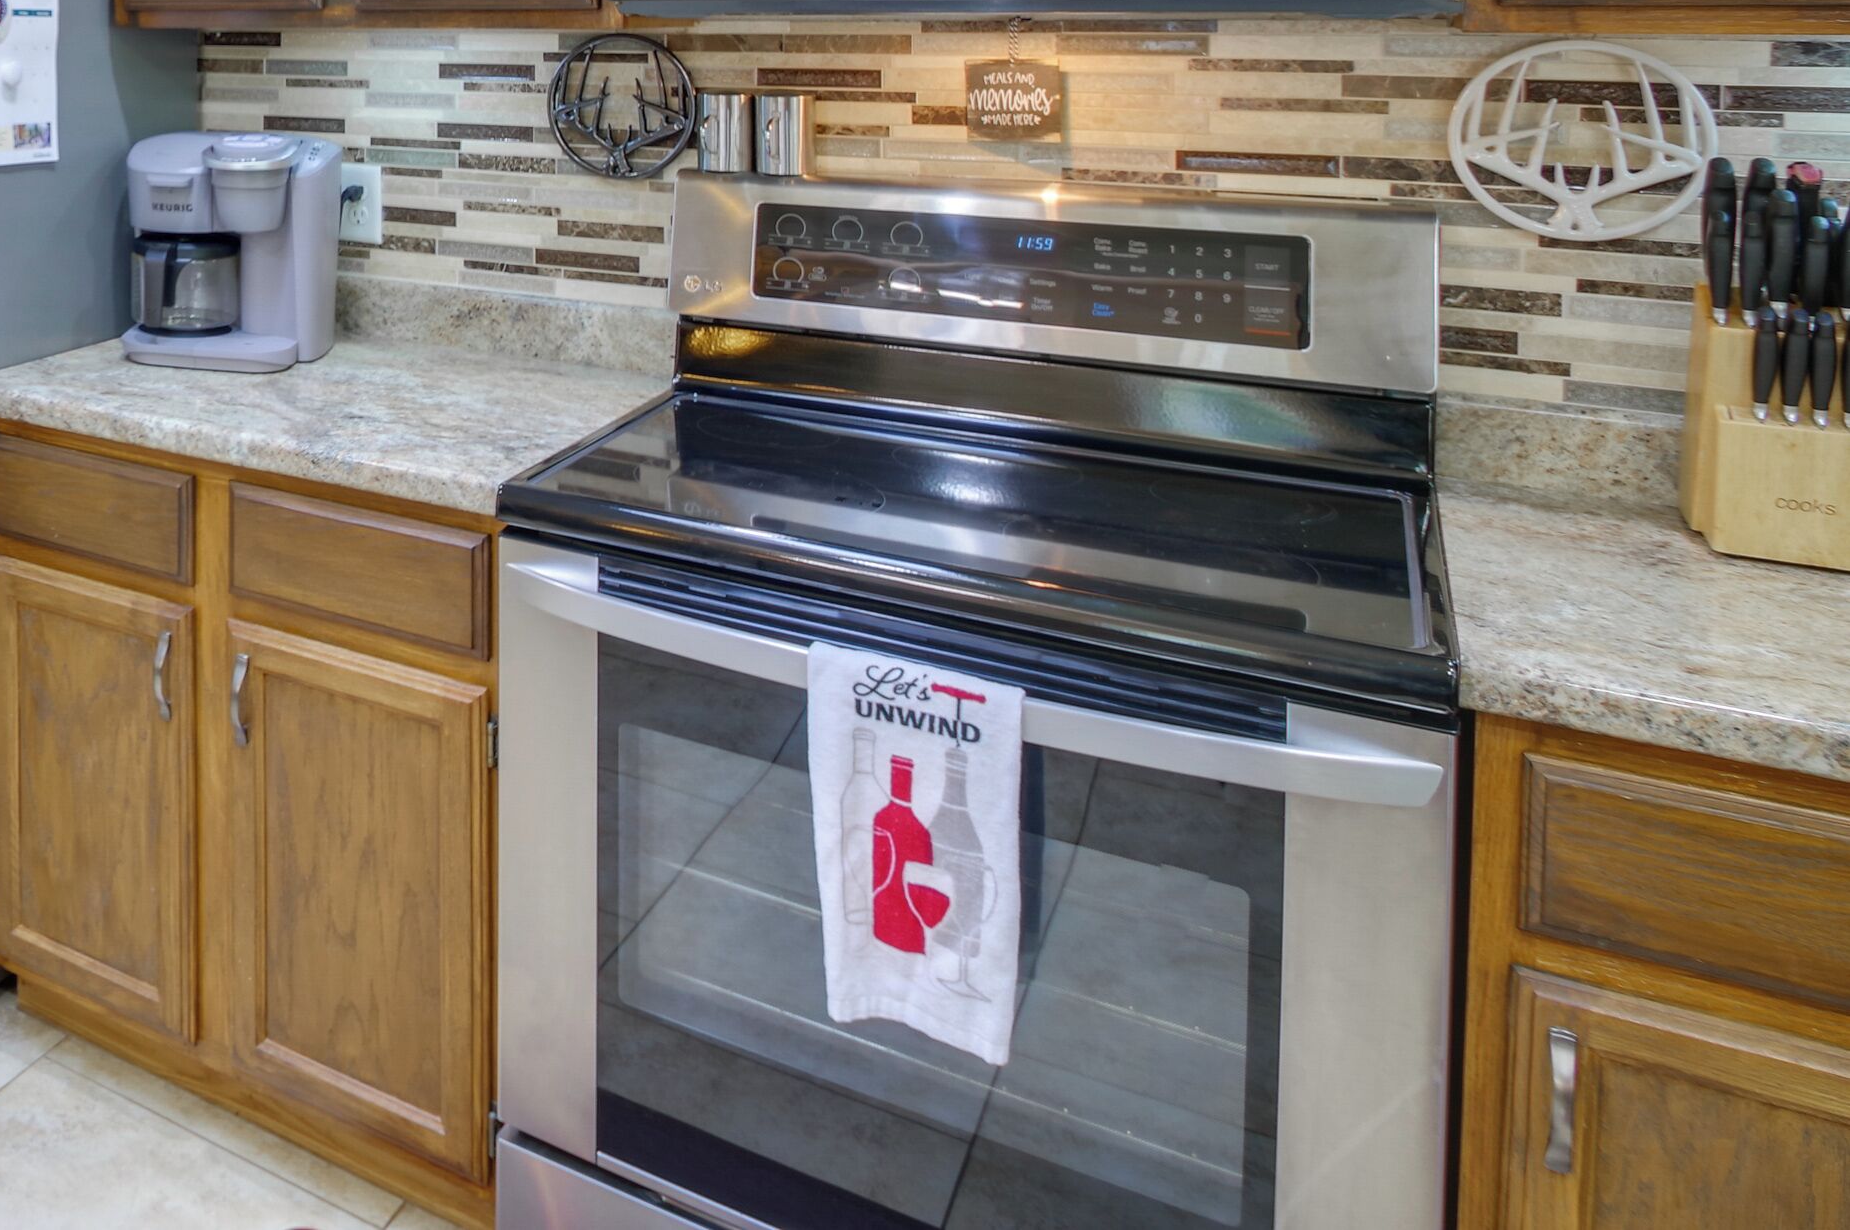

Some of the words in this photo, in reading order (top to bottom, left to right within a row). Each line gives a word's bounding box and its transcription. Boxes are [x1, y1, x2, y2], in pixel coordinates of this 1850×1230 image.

[983, 72, 1013, 85] MEALS
[1014, 72, 1035, 85] AND
[988, 114, 1012, 126] MADE
[1013, 113, 1034, 127] HERE
[151, 202, 193, 212] KEURIG
[1017, 236, 1054, 251] 11:59
[1169, 245, 1175, 254] 1
[1195, 247, 1204, 257] 2
[1223, 248, 1232, 259] 3
[1168, 267, 1175, 277] 4
[1195, 269, 1203, 279] 5
[1223, 271, 1232, 281] 6
[1168, 289, 1175, 299] 7
[1195, 291, 1203, 301] 8
[1223, 293, 1232, 304] 9
[1195, 313, 1203, 324] 0
[1774, 497, 1837, 516] cooks
[853, 665, 931, 701] Let's
[854, 698, 981, 744] UNWIND
